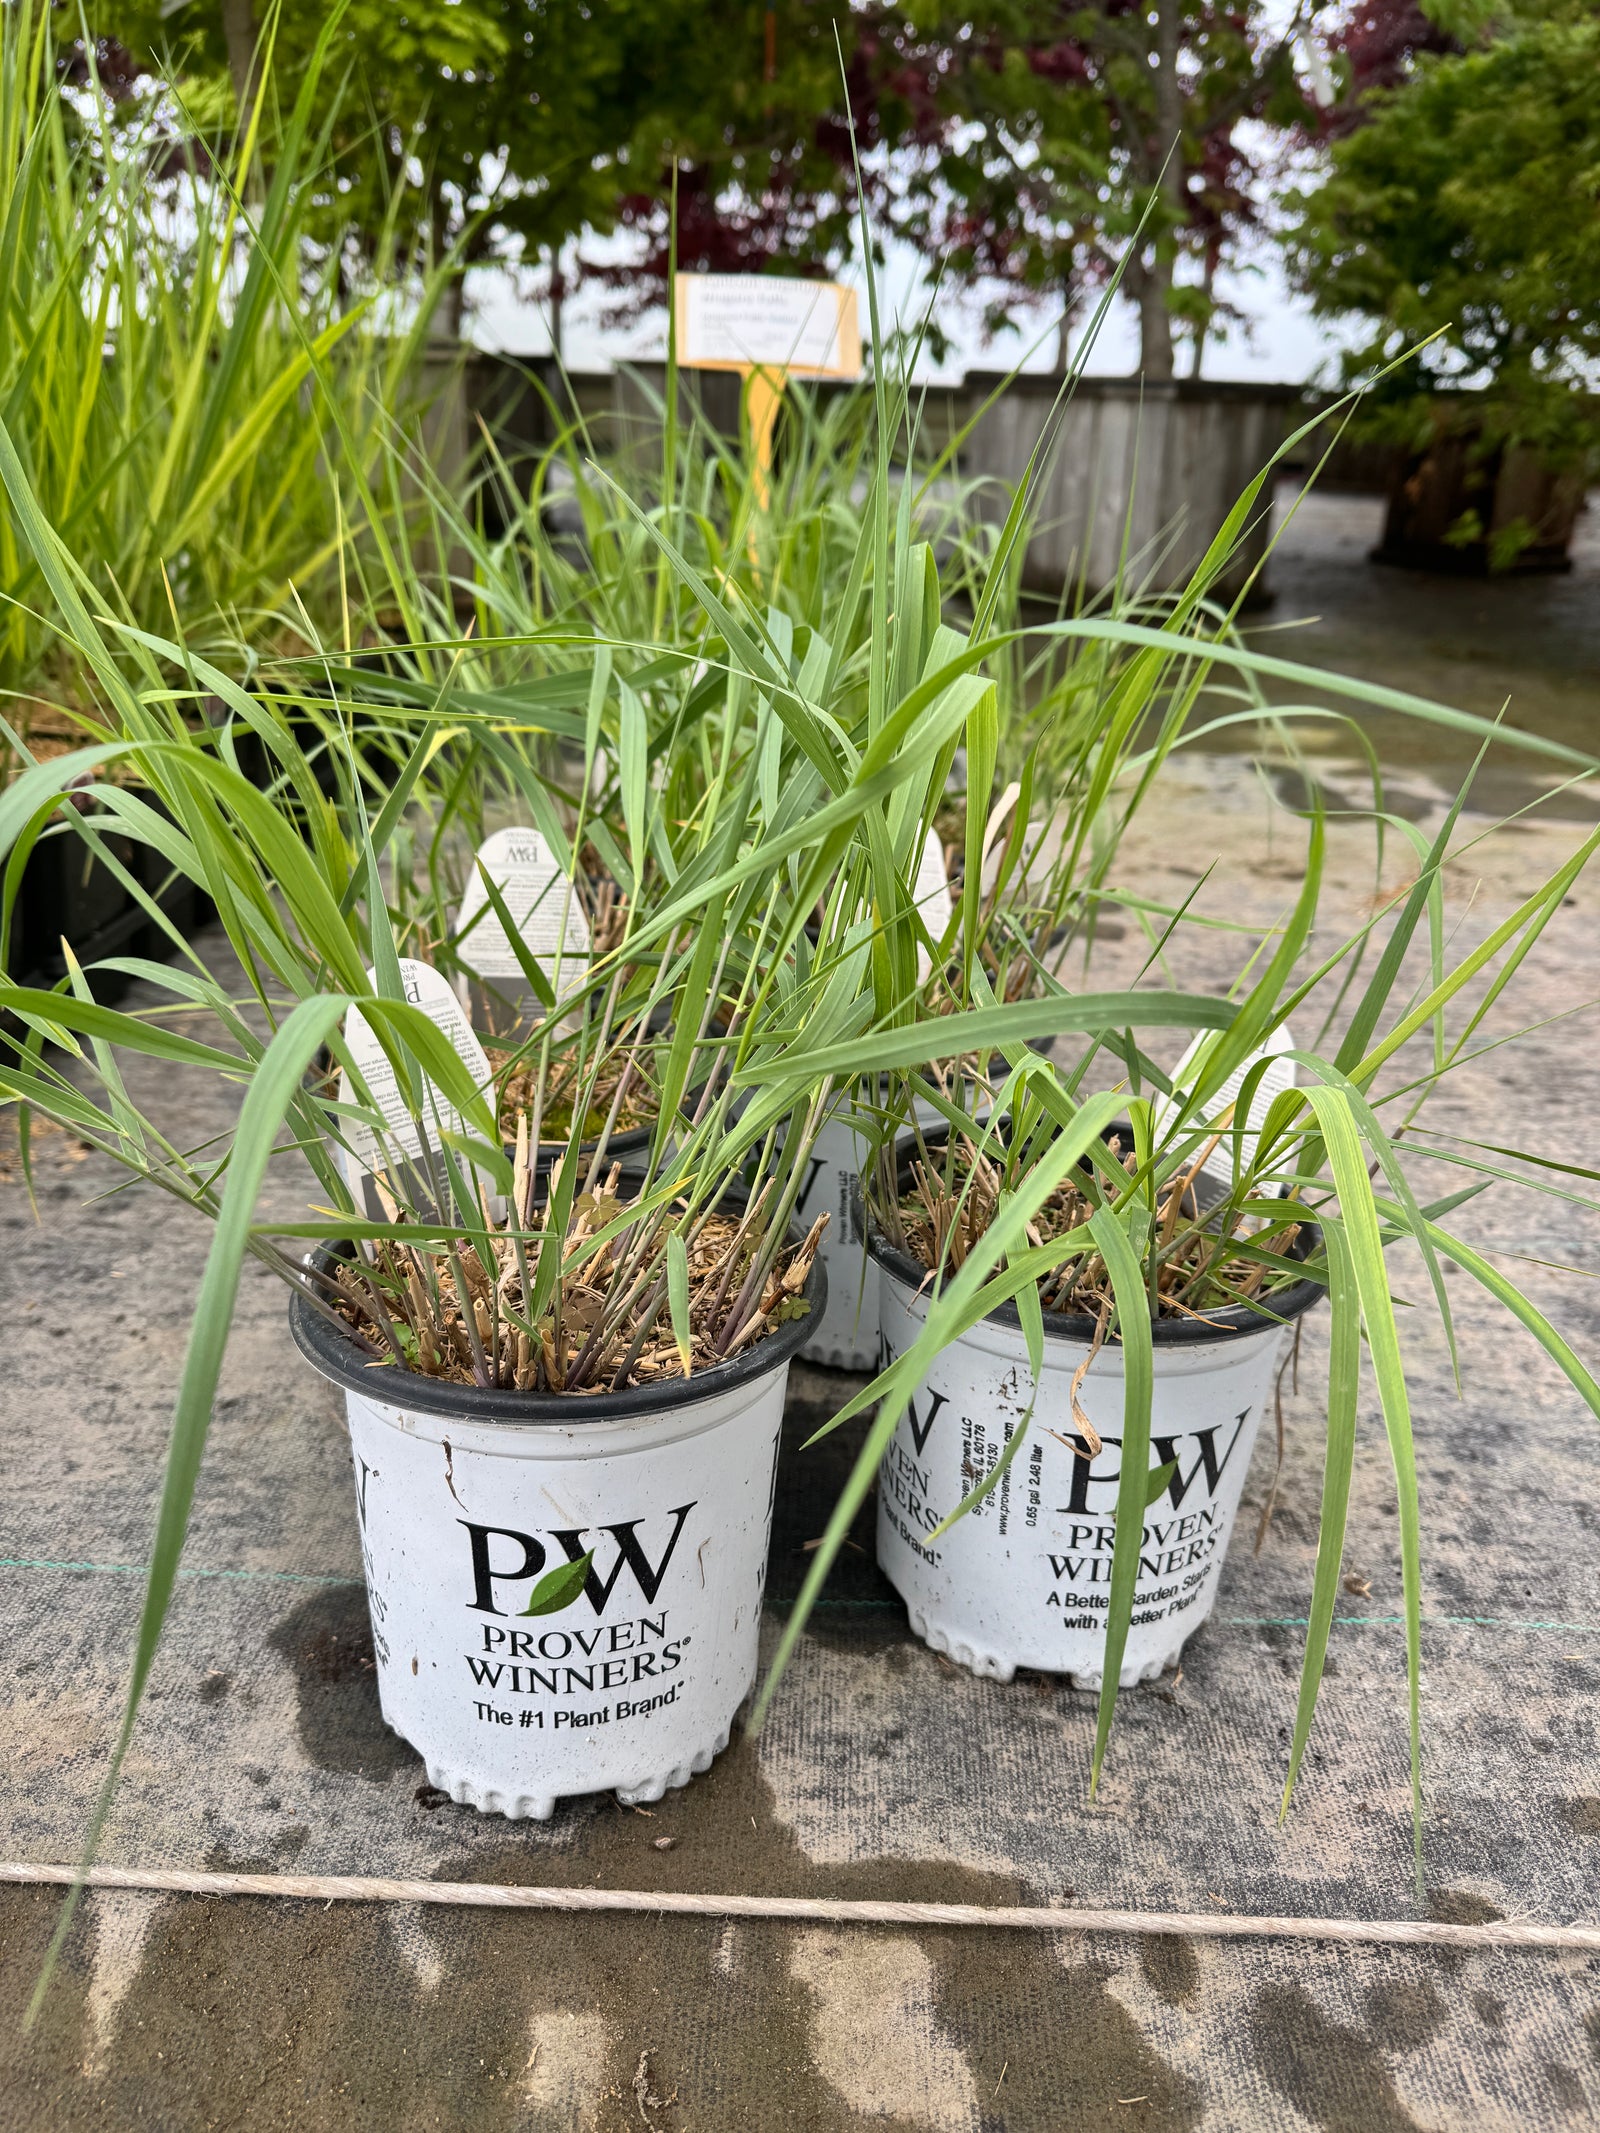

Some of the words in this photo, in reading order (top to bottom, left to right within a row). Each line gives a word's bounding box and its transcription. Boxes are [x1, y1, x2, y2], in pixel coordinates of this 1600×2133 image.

[962, 1417, 973, 1438] LLC
[973, 1424, 986, 1455] 60178
[973, 1457, 984, 1466] IL
[1030, 1444, 1043, 1463] liter
[1028, 1464, 1041, 1486] 2.48
[962, 1476, 971, 1503] oven
[1025, 1506, 1037, 1527] 0.65
[456, 1500, 698, 1617] PW
[1047, 1526, 1221, 1582] WINERS
[1046, 1591, 1061, 1609] A
[1065, 1592, 1109, 1609] Bette
[1064, 1613, 1098, 1630] with
[1130, 1608, 1167, 1627] etter
[481, 1610, 670, 1660] PROVEN
[473, 1700, 514, 1726] The
[519, 1710, 544, 1728] #1
[554, 1706, 610, 1729] Plant
